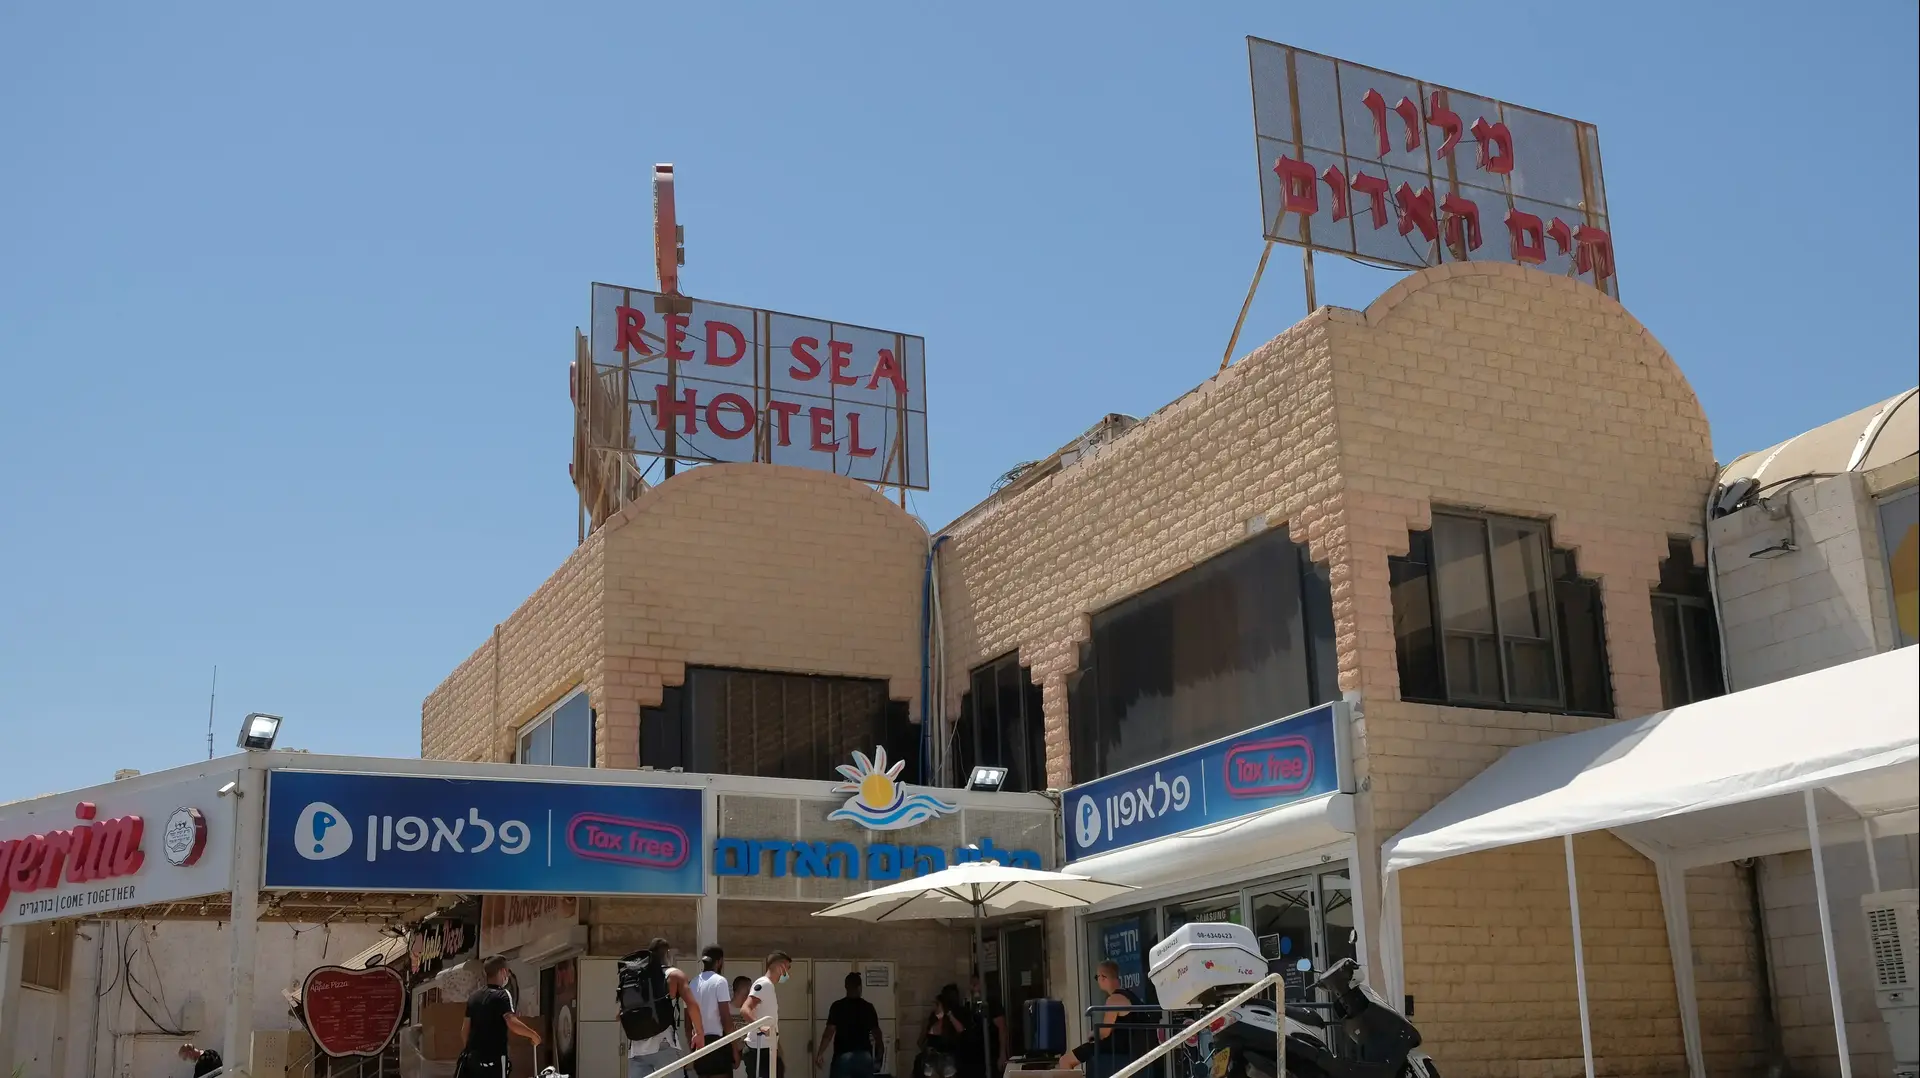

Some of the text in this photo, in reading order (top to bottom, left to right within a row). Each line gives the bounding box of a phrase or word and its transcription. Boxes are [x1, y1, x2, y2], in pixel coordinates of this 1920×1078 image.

[1362, 88, 1513, 174] מלון
[1273, 154, 1613, 279] הים האדום
[614, 305, 909, 394] RED SEA
[654, 384, 877, 458] HOTEL
[1235, 753, 1303, 782] Tax free
[1106, 771, 1191, 841] פלאפון
[367, 807, 531, 862] פלאפון
[585, 825, 674, 857] Tax free
[713, 837, 859, 879] האדום
[867, 843, 944, 880] הים
[19, 898, 53, 916] בורגרים
[60, 885, 136, 910] COME TOGETHER
[1195, 910, 1226, 922] SAMSUNG
[1119, 928, 1139, 953] יחד
